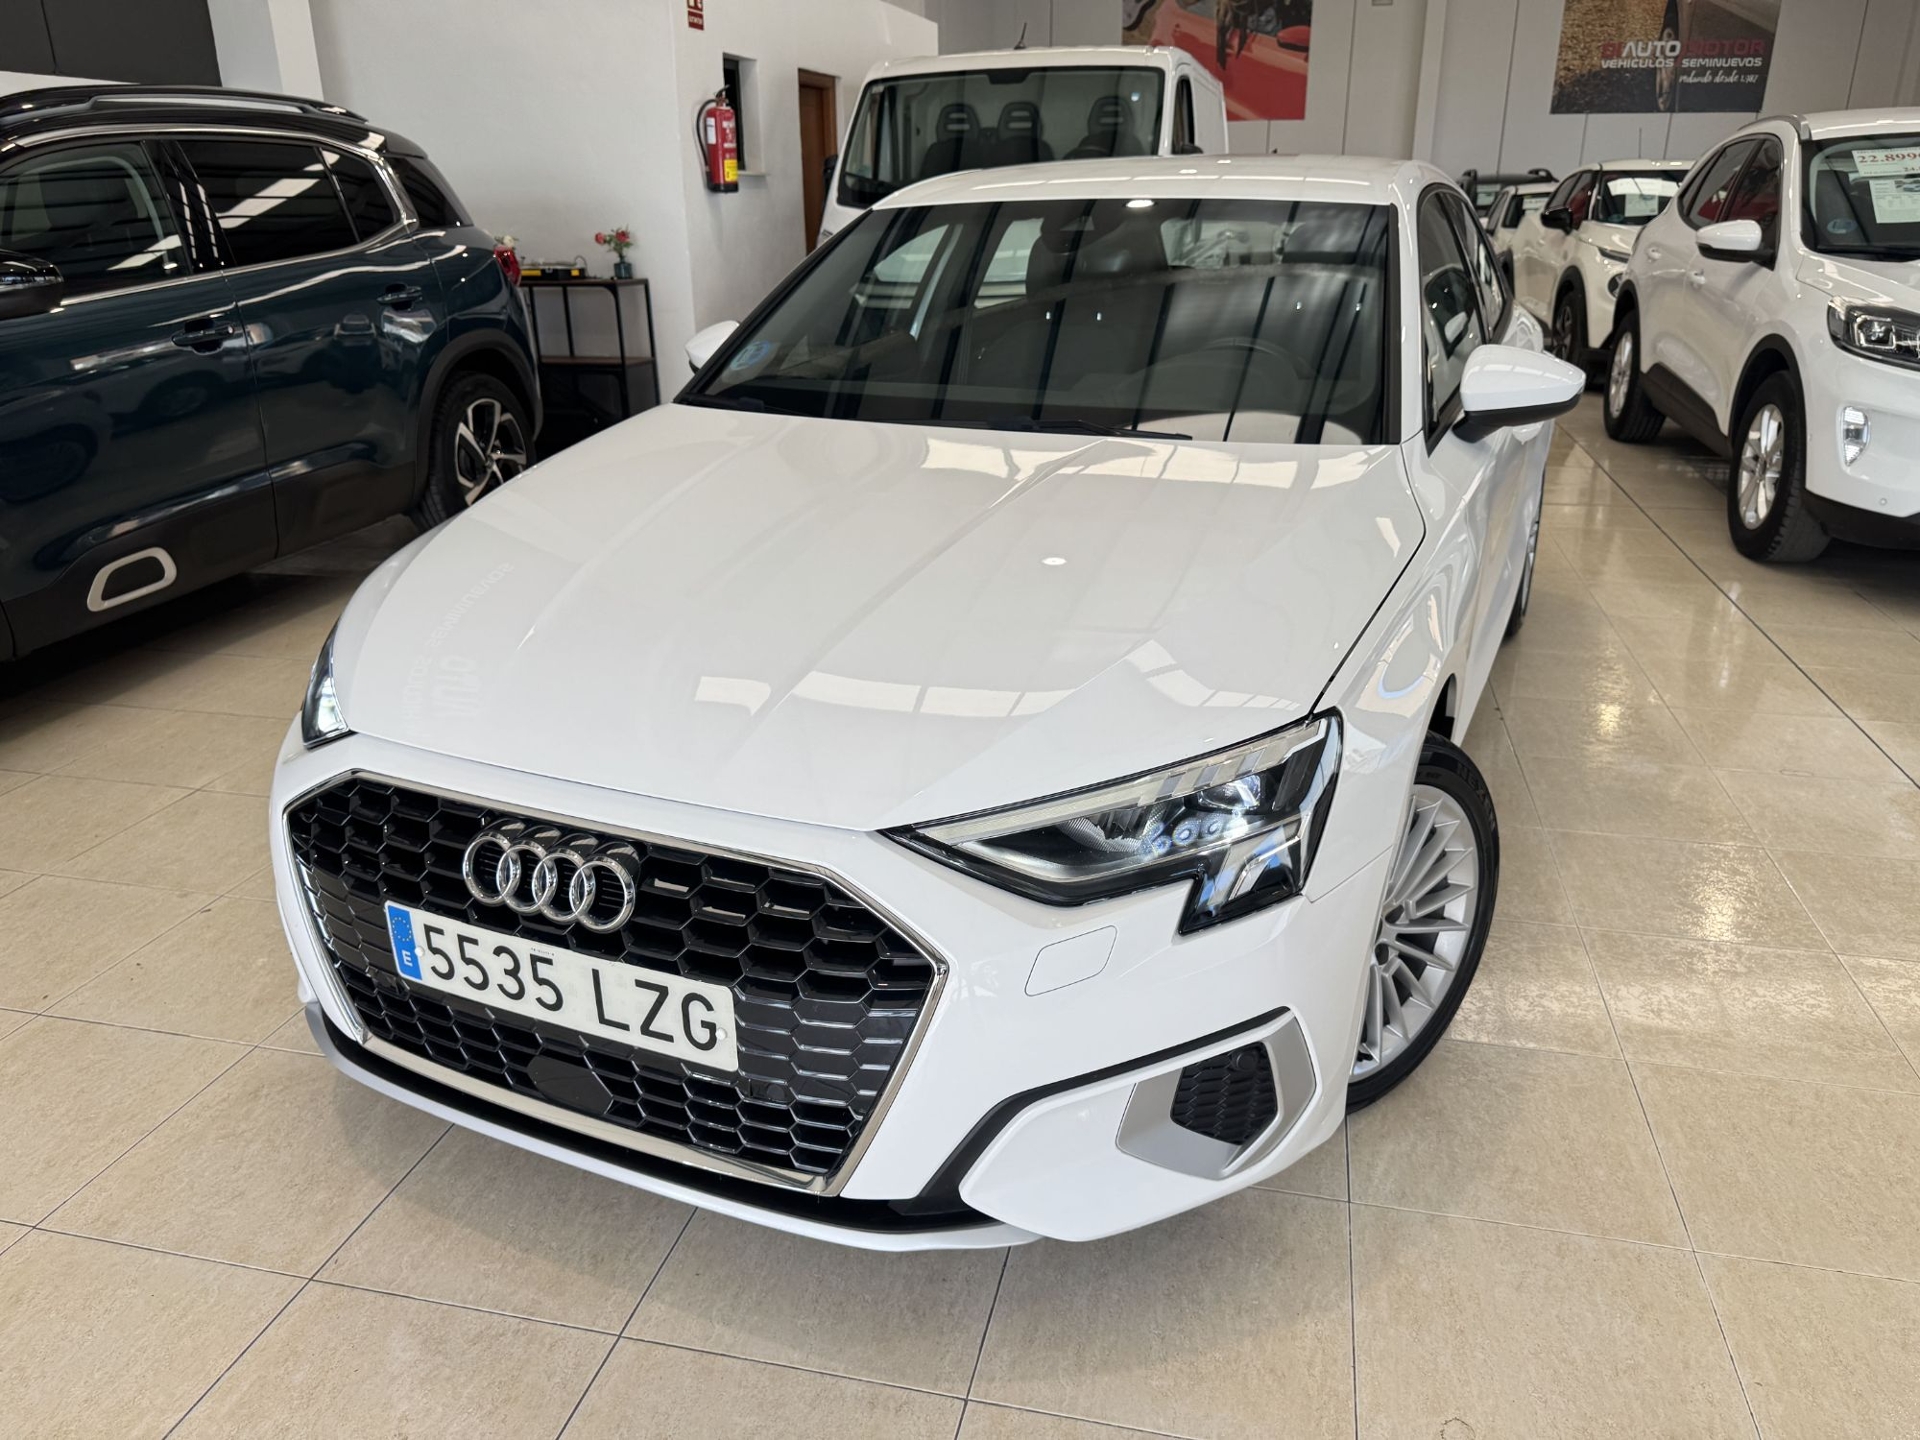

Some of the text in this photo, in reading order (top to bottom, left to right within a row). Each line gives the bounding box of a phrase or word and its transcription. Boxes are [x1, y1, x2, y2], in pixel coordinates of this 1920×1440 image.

[1681, 57, 1762, 67] SEMINUEVOS
[1714, 70, 1738, 83] desde
[1857, 152, 1920, 163] 22.899
[402, 951, 413, 966] E
[423, 923, 718, 1052] 5535 LZG
